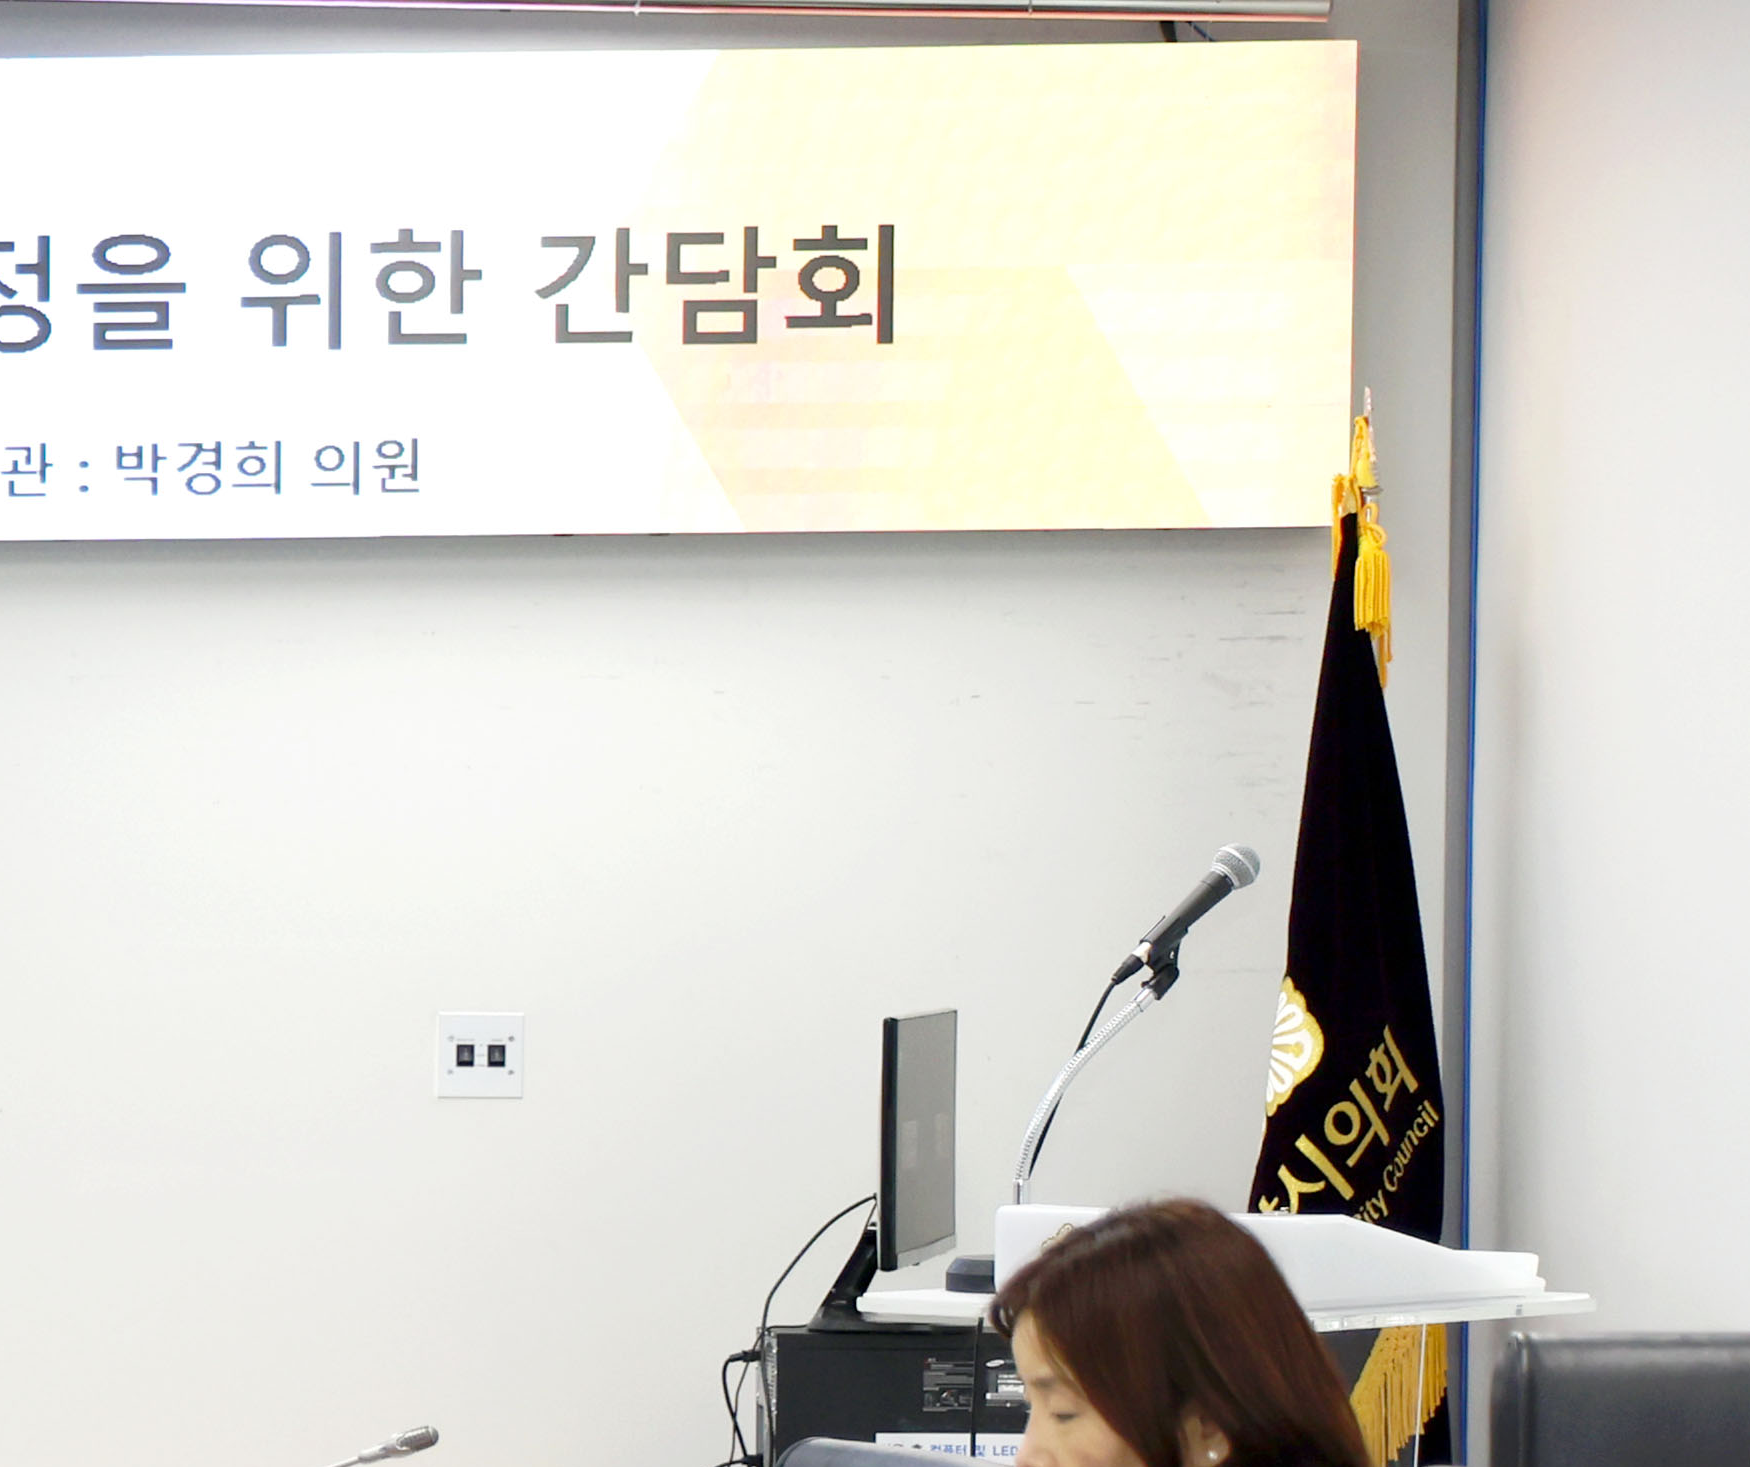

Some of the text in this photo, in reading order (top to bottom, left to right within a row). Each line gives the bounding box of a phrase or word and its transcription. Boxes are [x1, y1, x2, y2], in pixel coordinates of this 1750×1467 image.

[240, 228, 483, 350] 위한
[535, 223, 900, 345] 간담회
[78, 460, 90, 493] :
[115, 440, 282, 496] 박경희
[310, 437, 420, 496] 의원
[1382, 1100, 1440, 1193] Council
